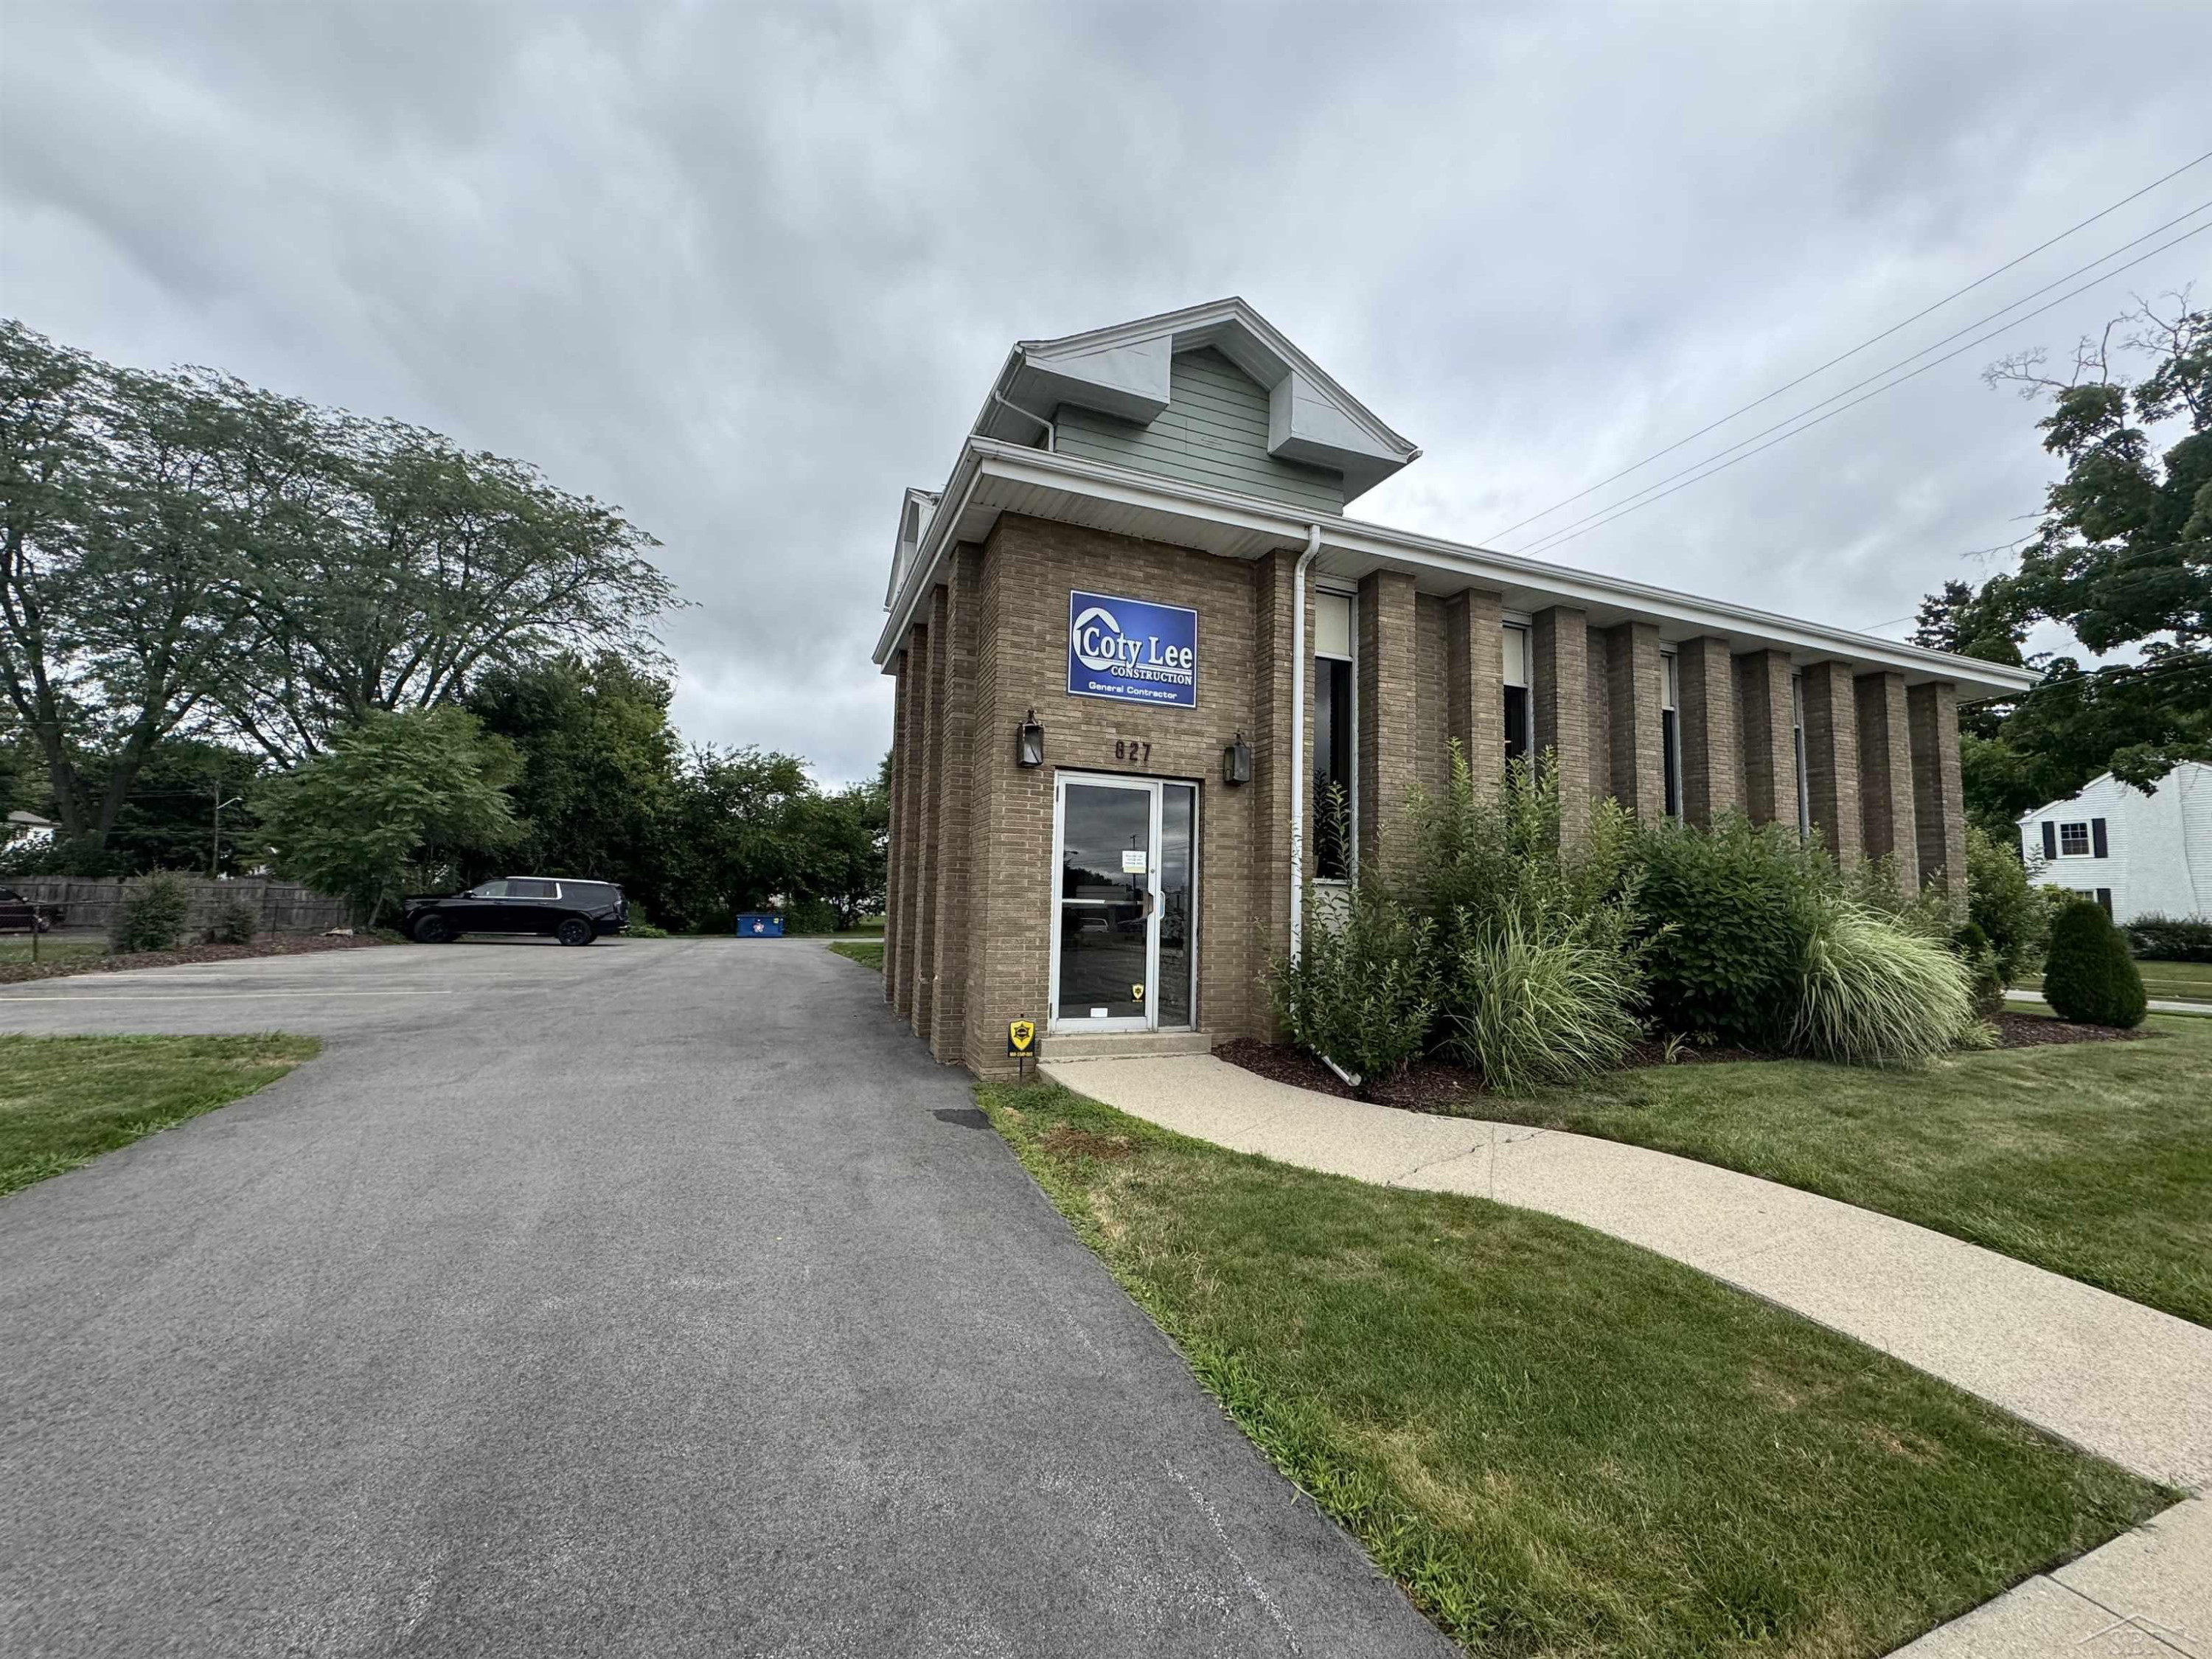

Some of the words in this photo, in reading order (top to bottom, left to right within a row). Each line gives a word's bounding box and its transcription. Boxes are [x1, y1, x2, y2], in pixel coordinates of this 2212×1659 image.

[1083, 627, 1142, 668] Coty
[1149, 636, 1192, 668] Lee
[1111, 666, 1192, 685] CONSTRUCTION
[1088, 681, 1124, 693] General
[1127, 686, 1178, 699] Contractor
